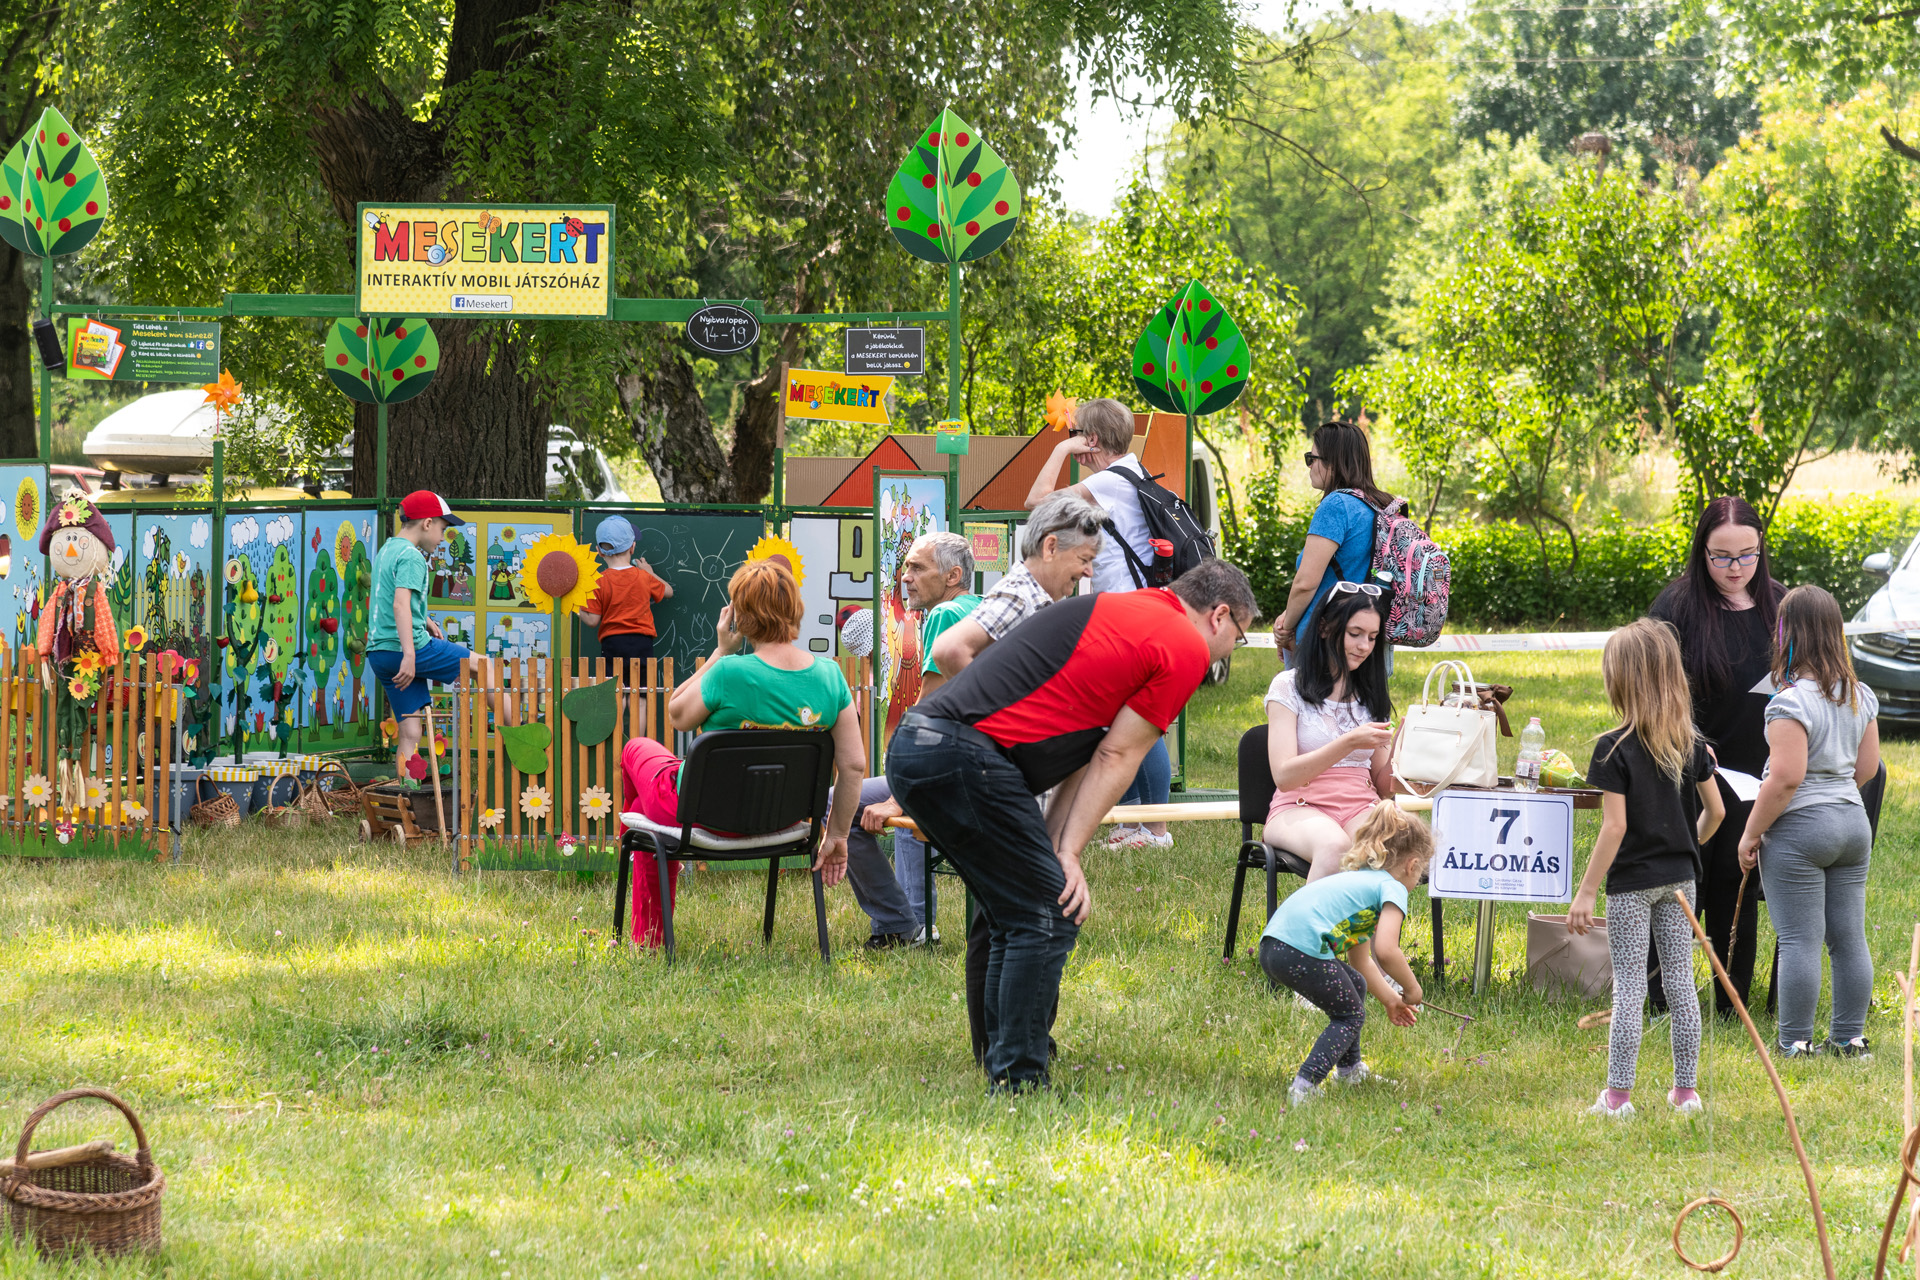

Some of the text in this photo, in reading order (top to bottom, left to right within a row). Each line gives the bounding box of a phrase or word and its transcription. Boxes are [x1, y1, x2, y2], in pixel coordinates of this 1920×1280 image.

[373, 220, 606, 264] MESEKERT
[367, 272, 601, 289] INTERAKTÍV MOBIL JÁTSZÓHÁZ
[466, 299, 508, 309] Mesekert
[132, 330, 167, 338] Mesekert
[790, 384, 879, 408] MESEKERT
[1489, 808, 1533, 846] 7.
[1442, 846, 1560, 874] ÁLLOMÁS
